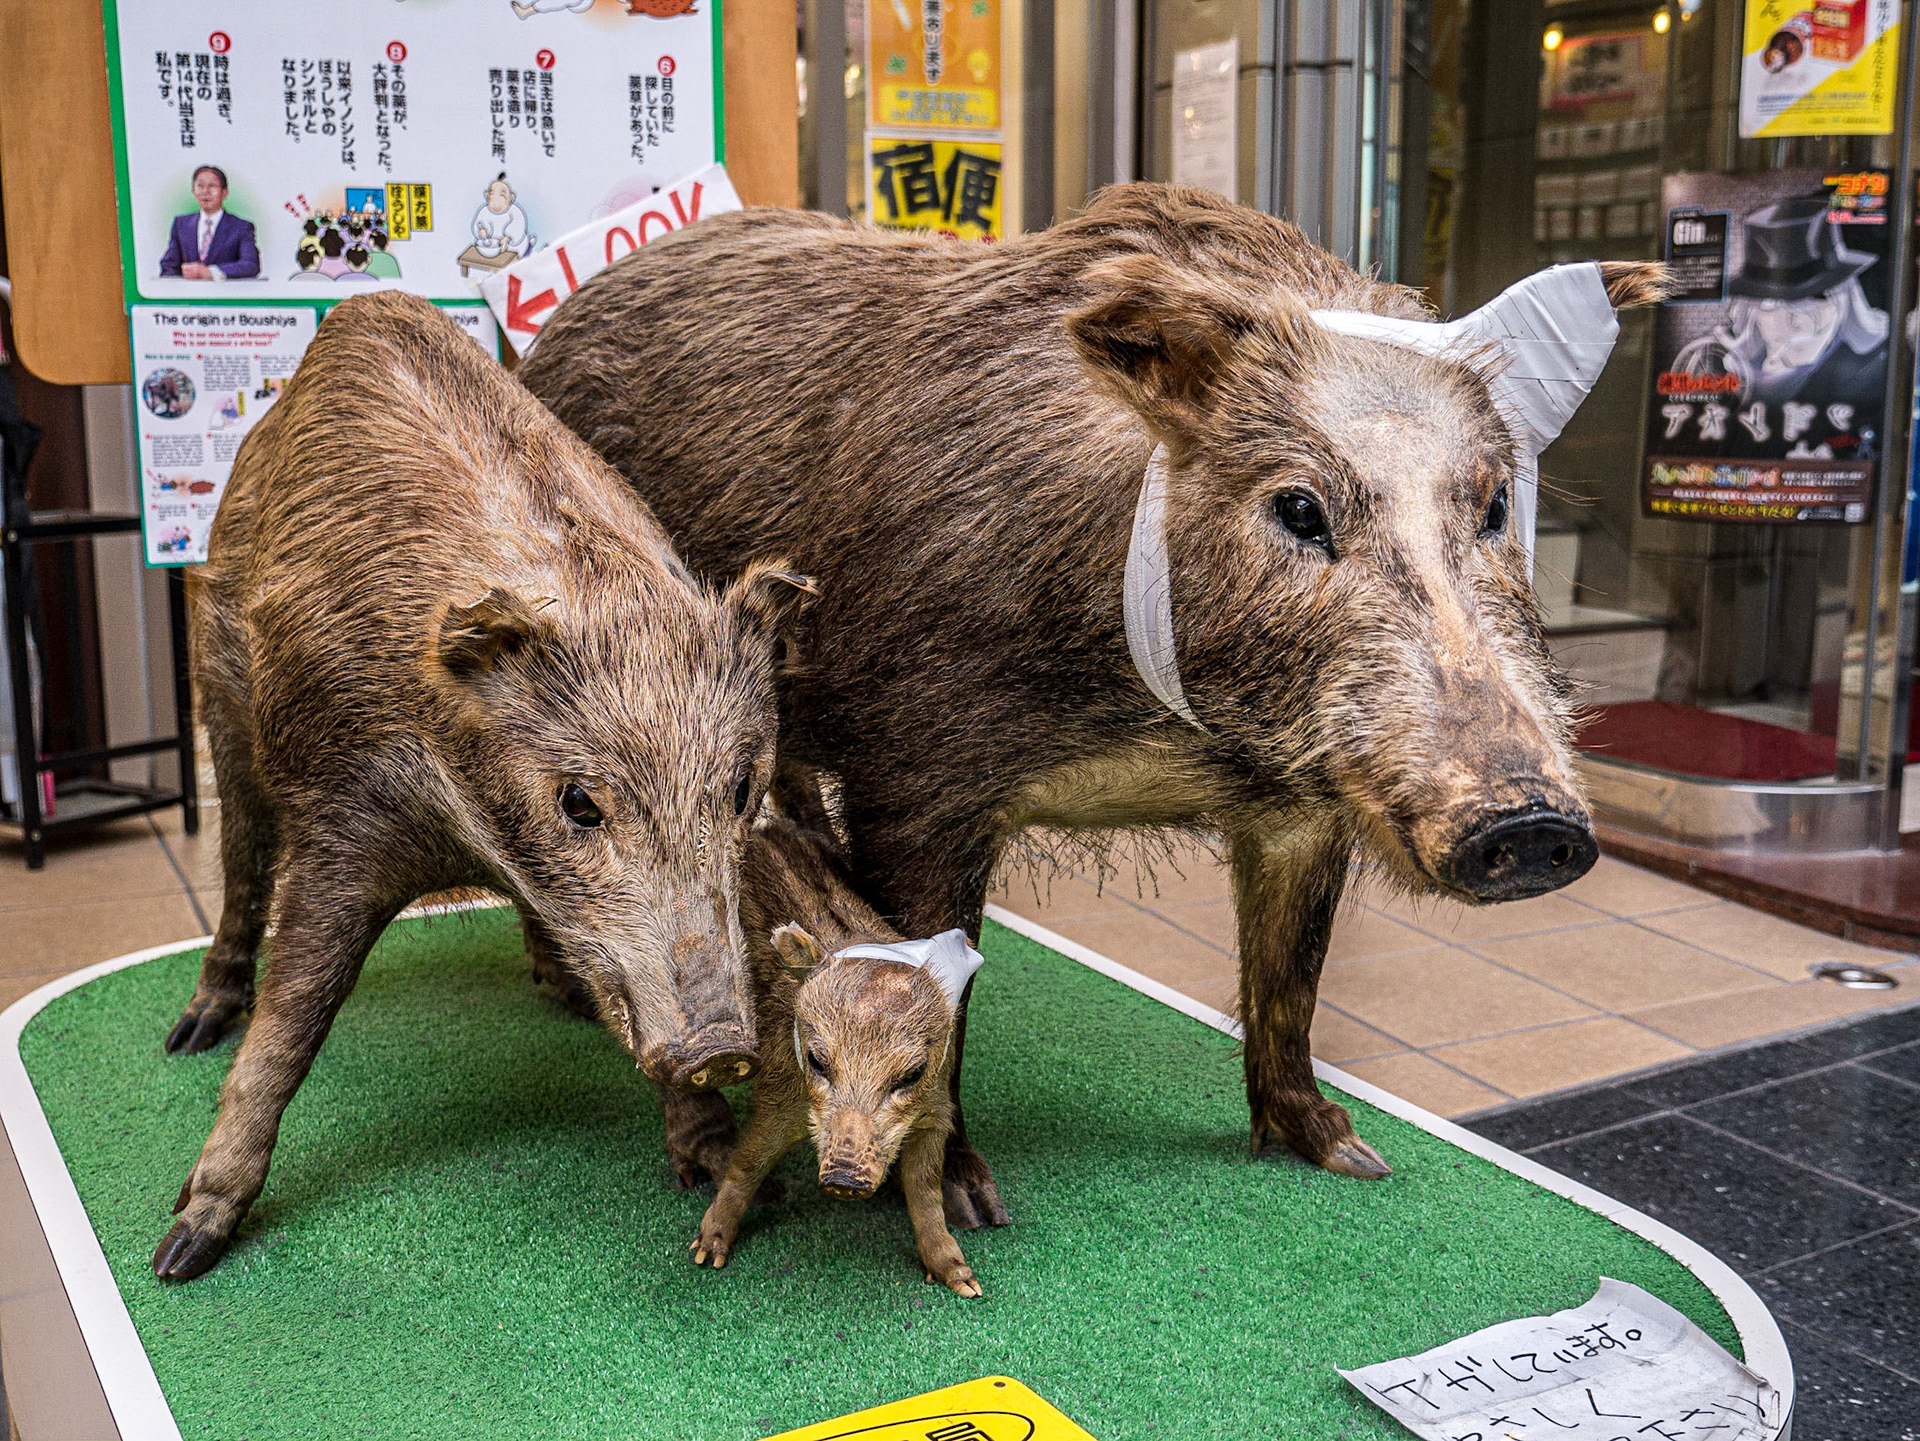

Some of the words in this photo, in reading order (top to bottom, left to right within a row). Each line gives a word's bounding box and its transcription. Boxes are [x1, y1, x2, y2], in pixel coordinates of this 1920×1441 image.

[155, 51, 175, 107] 私です。
[176, 52, 195, 148] 第14代当主は
[194, 53, 212, 101] 現在の
[282, 58, 301, 144] なりました。
[300, 59, 318, 134] シンボルと
[523, 69, 538, 136] 店に帰り、
[645, 75, 660, 147] 探していた
[661, 77, 675, 134] 目の前に
[629, 75, 645, 165] 薬草があった。
[871, 143, 1001, 233] 宿便
[153, 314, 178, 326] The
[181, 314, 219, 328] origin
[222, 315, 235, 326] of
[239, 314, 297, 328] Boushiya
